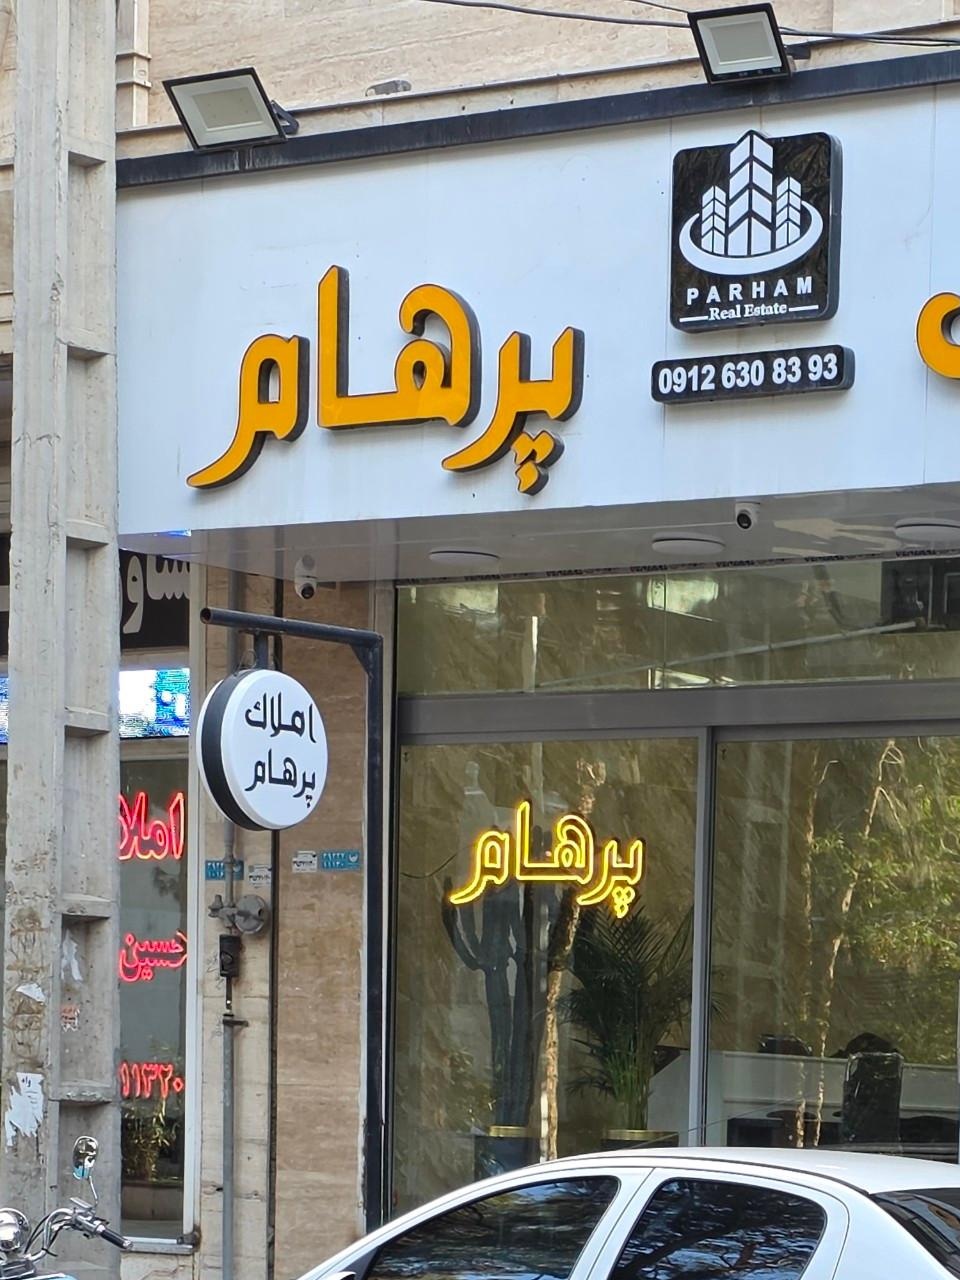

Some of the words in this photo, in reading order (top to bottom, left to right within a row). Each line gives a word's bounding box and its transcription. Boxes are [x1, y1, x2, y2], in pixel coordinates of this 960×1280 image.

[686, 276, 812, 305] PARHAM
[708, 304, 742, 321] Real
[743, 302, 788, 318] Estate
[186, 265, 584, 496] پرهام
[658, 364, 716, 395] 0912
[721, 360, 765, 389] 630
[772, 356, 802, 384] 83
[808, 353, 838, 381] 93
[244, 690, 317, 744] املاک
[244, 747, 316, 809] پرهام
[118, 791, 185, 860] املا
[449, 800, 644, 919] پرهام
